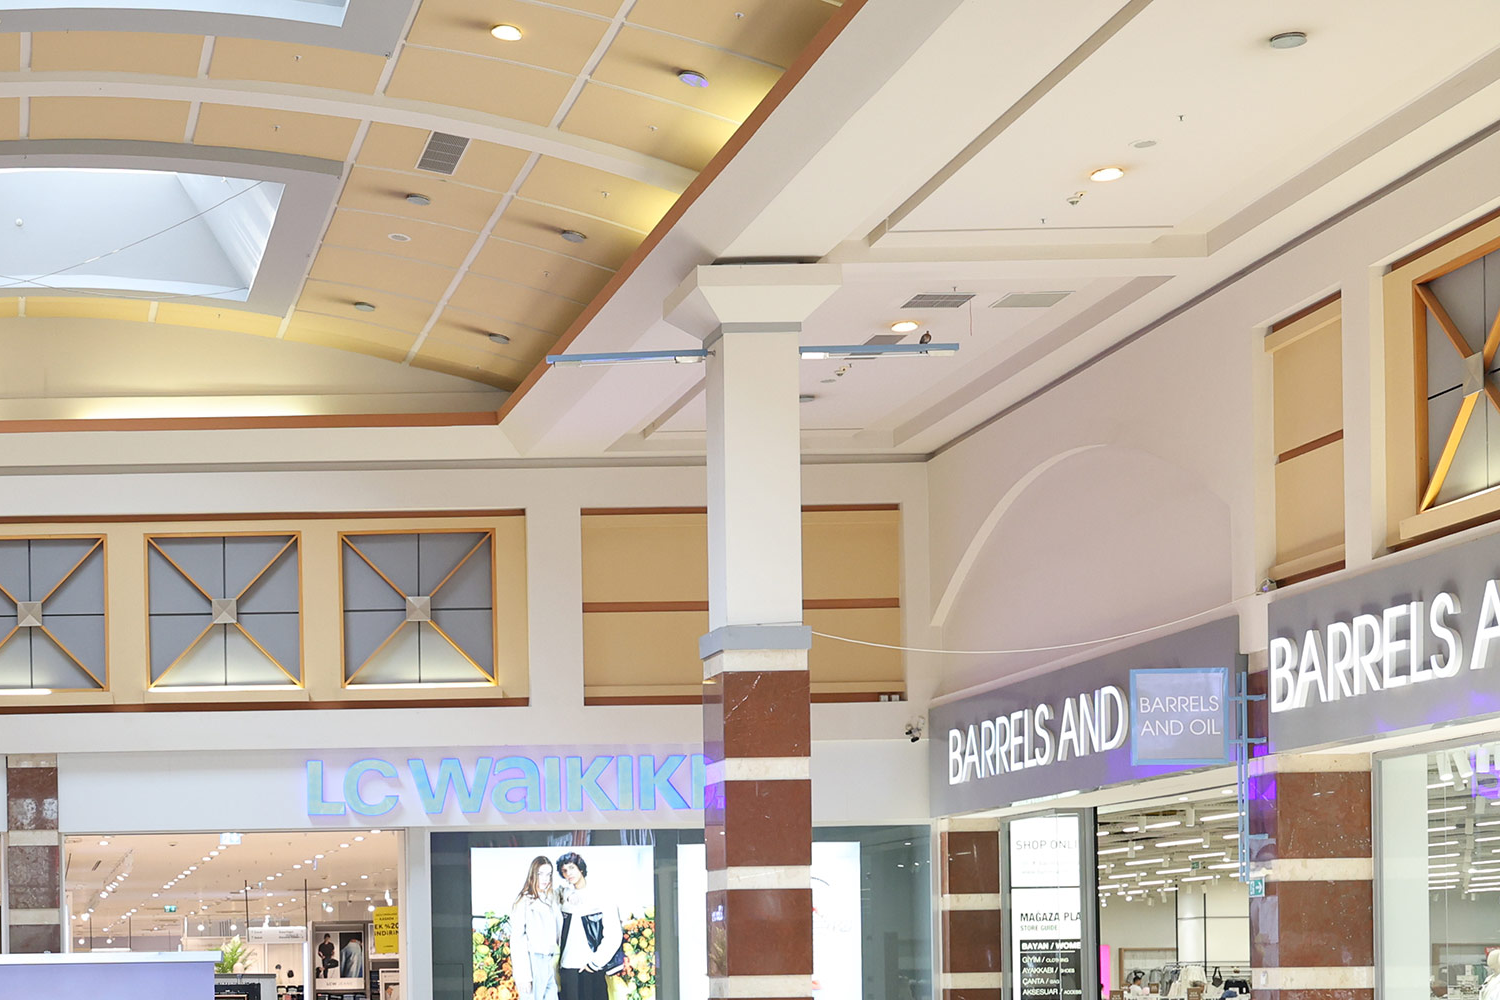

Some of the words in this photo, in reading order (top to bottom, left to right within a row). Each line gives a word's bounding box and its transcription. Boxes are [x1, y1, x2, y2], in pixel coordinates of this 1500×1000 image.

[1270, 592, 1463, 713] BARRELS
[1139, 695, 1220, 713] BARRELS
[949, 703, 1053, 785] BARRELS
[1057, 685, 1126, 762] AND
[1140, 720, 1185, 737] AND
[1189, 718, 1221, 736] OIL
[306, 758, 400, 817] LC
[1016, 840, 1047, 850] SHOP
[1021, 942, 1049, 950] BAYAN
